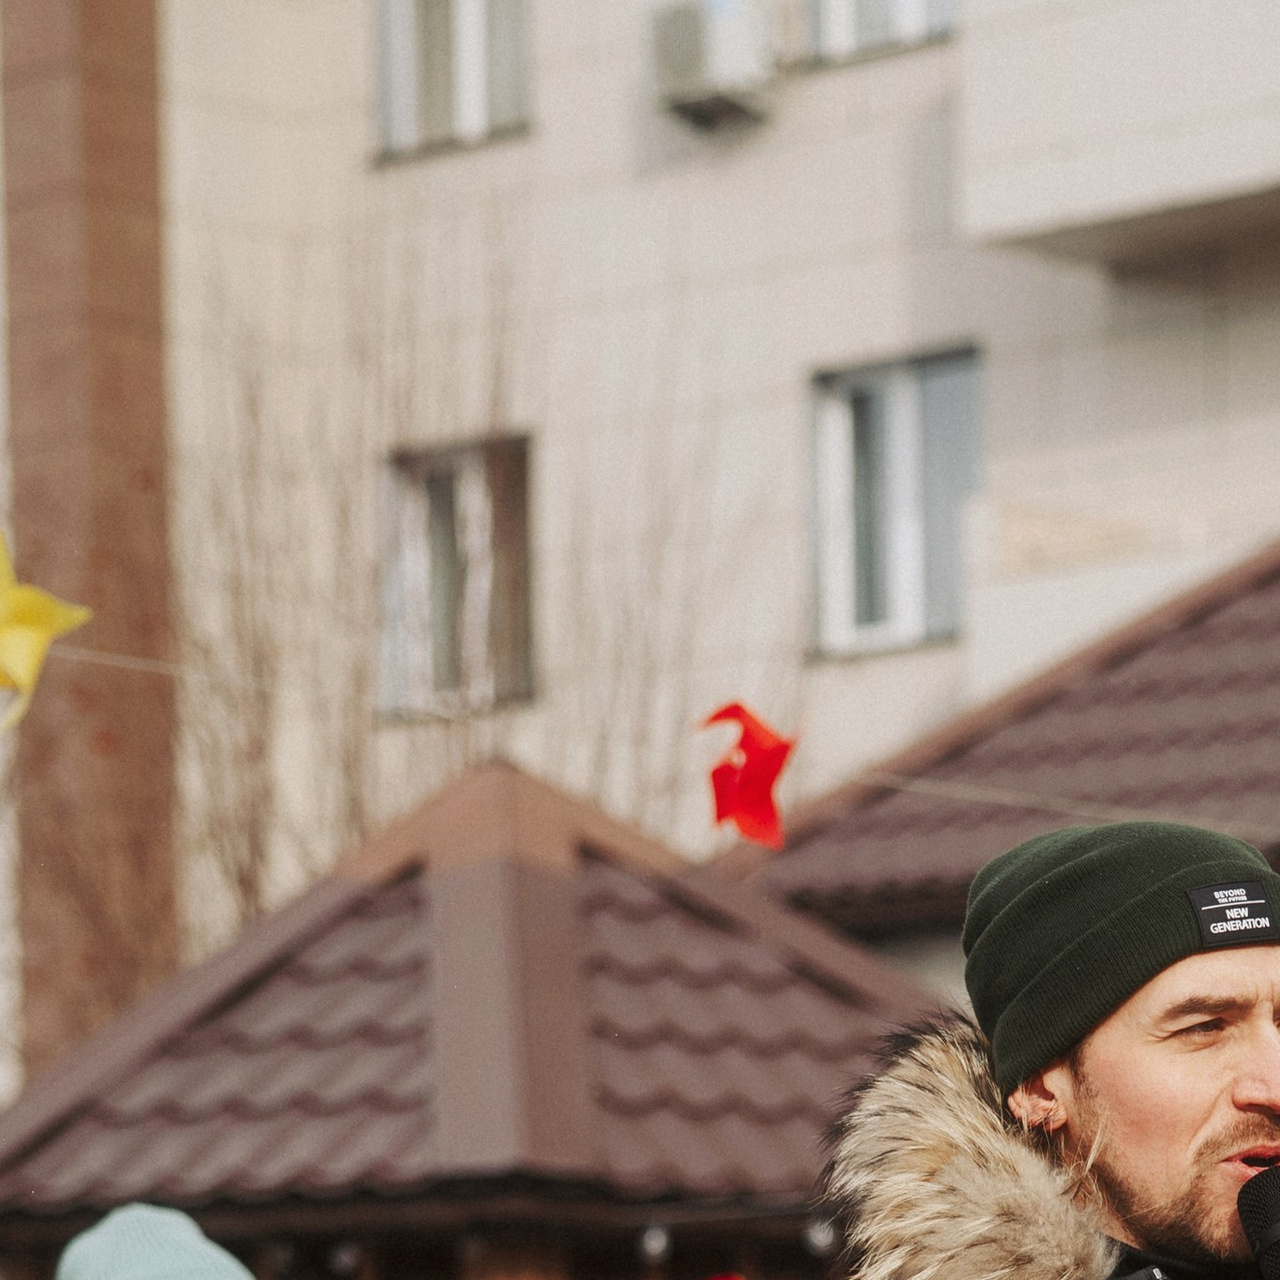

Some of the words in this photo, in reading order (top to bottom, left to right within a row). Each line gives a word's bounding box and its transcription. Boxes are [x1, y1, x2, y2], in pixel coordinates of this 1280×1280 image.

[1213, 888, 1246, 898] BEYOND
[1225, 907, 1249, 919] NEW
[1210, 917, 1270, 934] GENERATION
